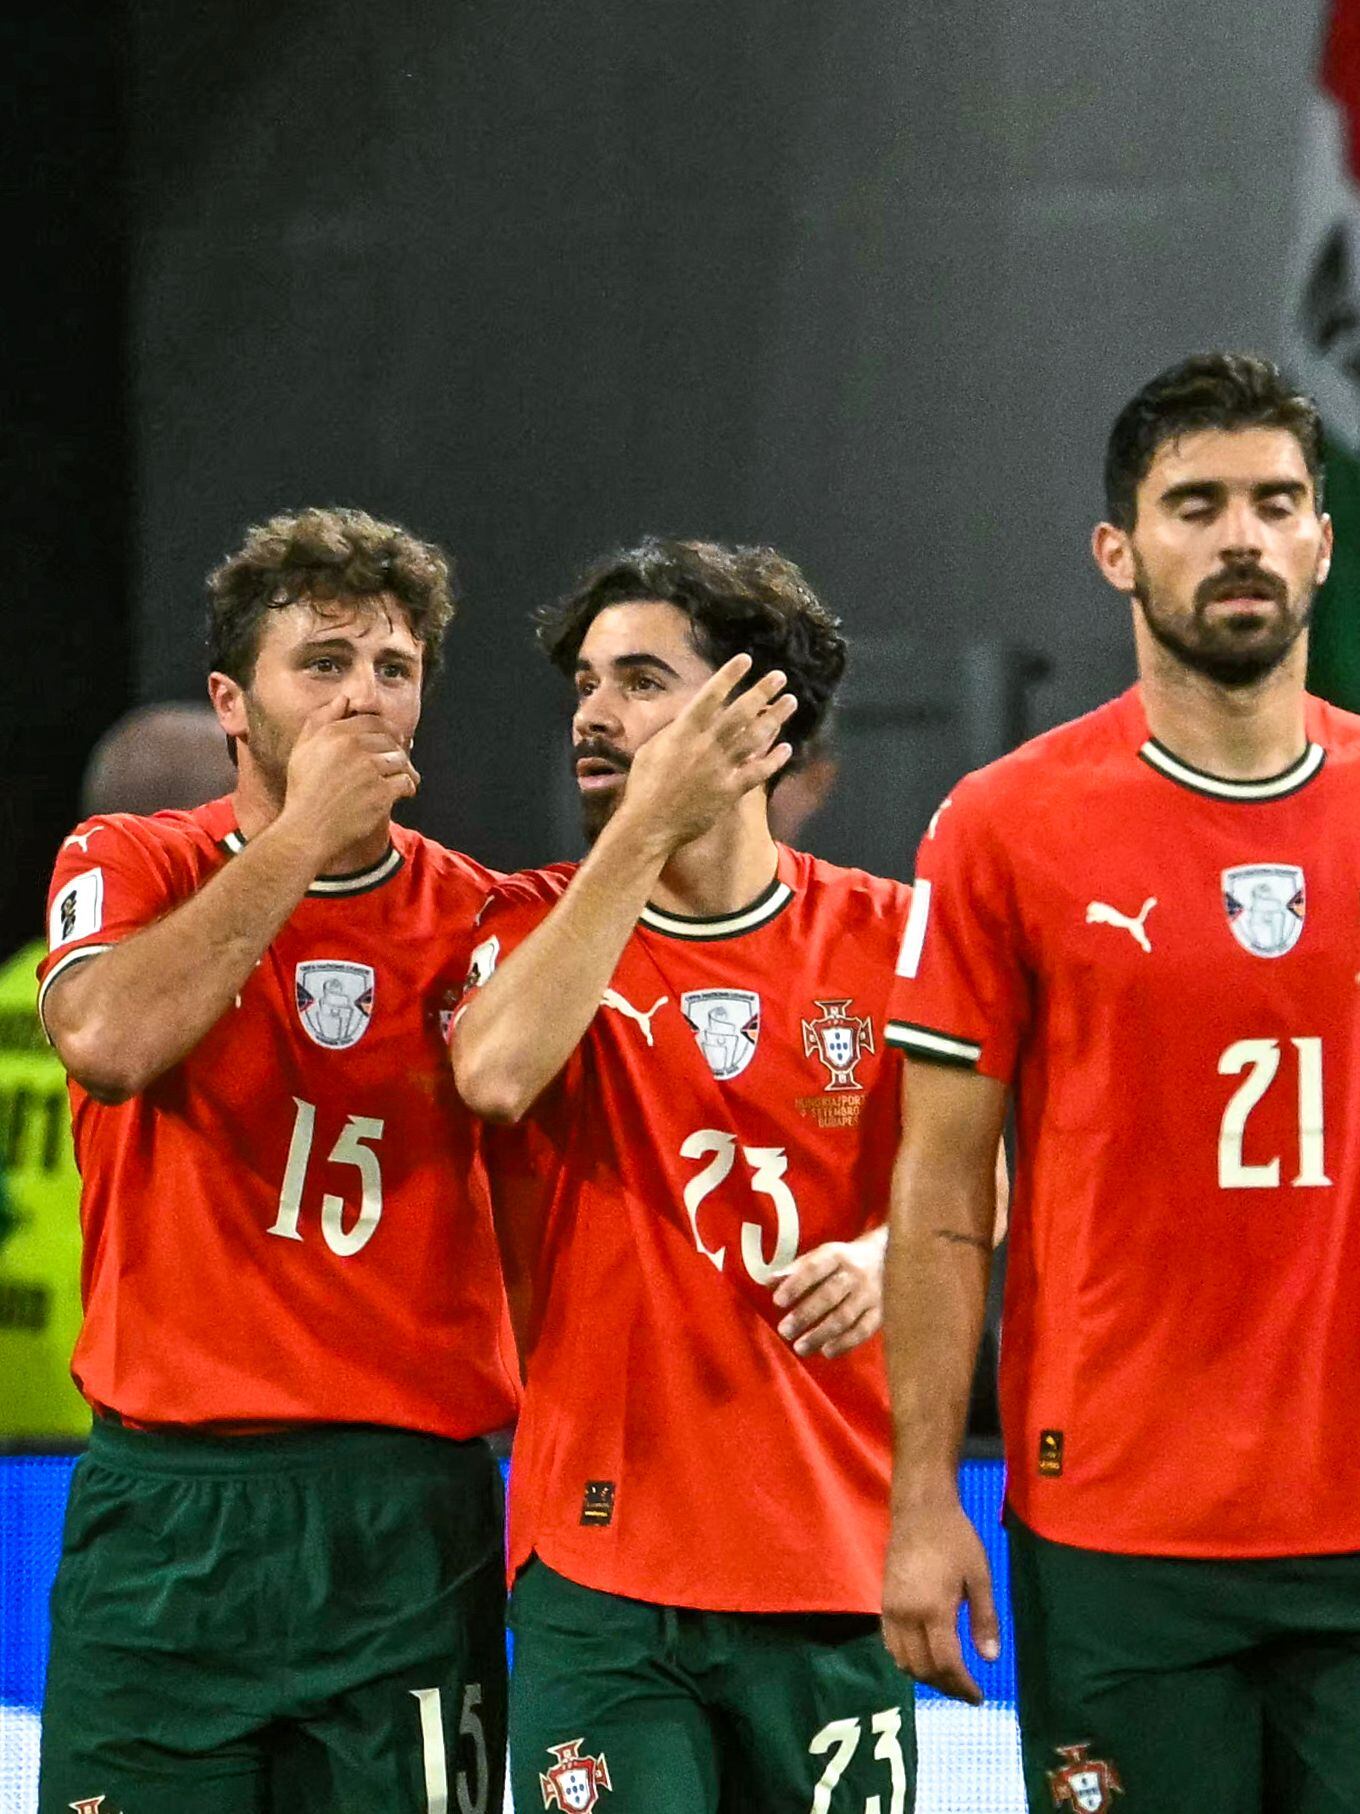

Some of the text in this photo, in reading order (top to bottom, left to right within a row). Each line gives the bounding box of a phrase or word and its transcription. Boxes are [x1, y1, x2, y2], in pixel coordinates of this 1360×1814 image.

[267, 1096, 384, 1257] 15
[1218, 1037, 1333, 1189] 21
[680, 1129, 800, 1286] 23
[409, 1683, 489, 1814] 15
[809, 1706, 907, 1814] 23
